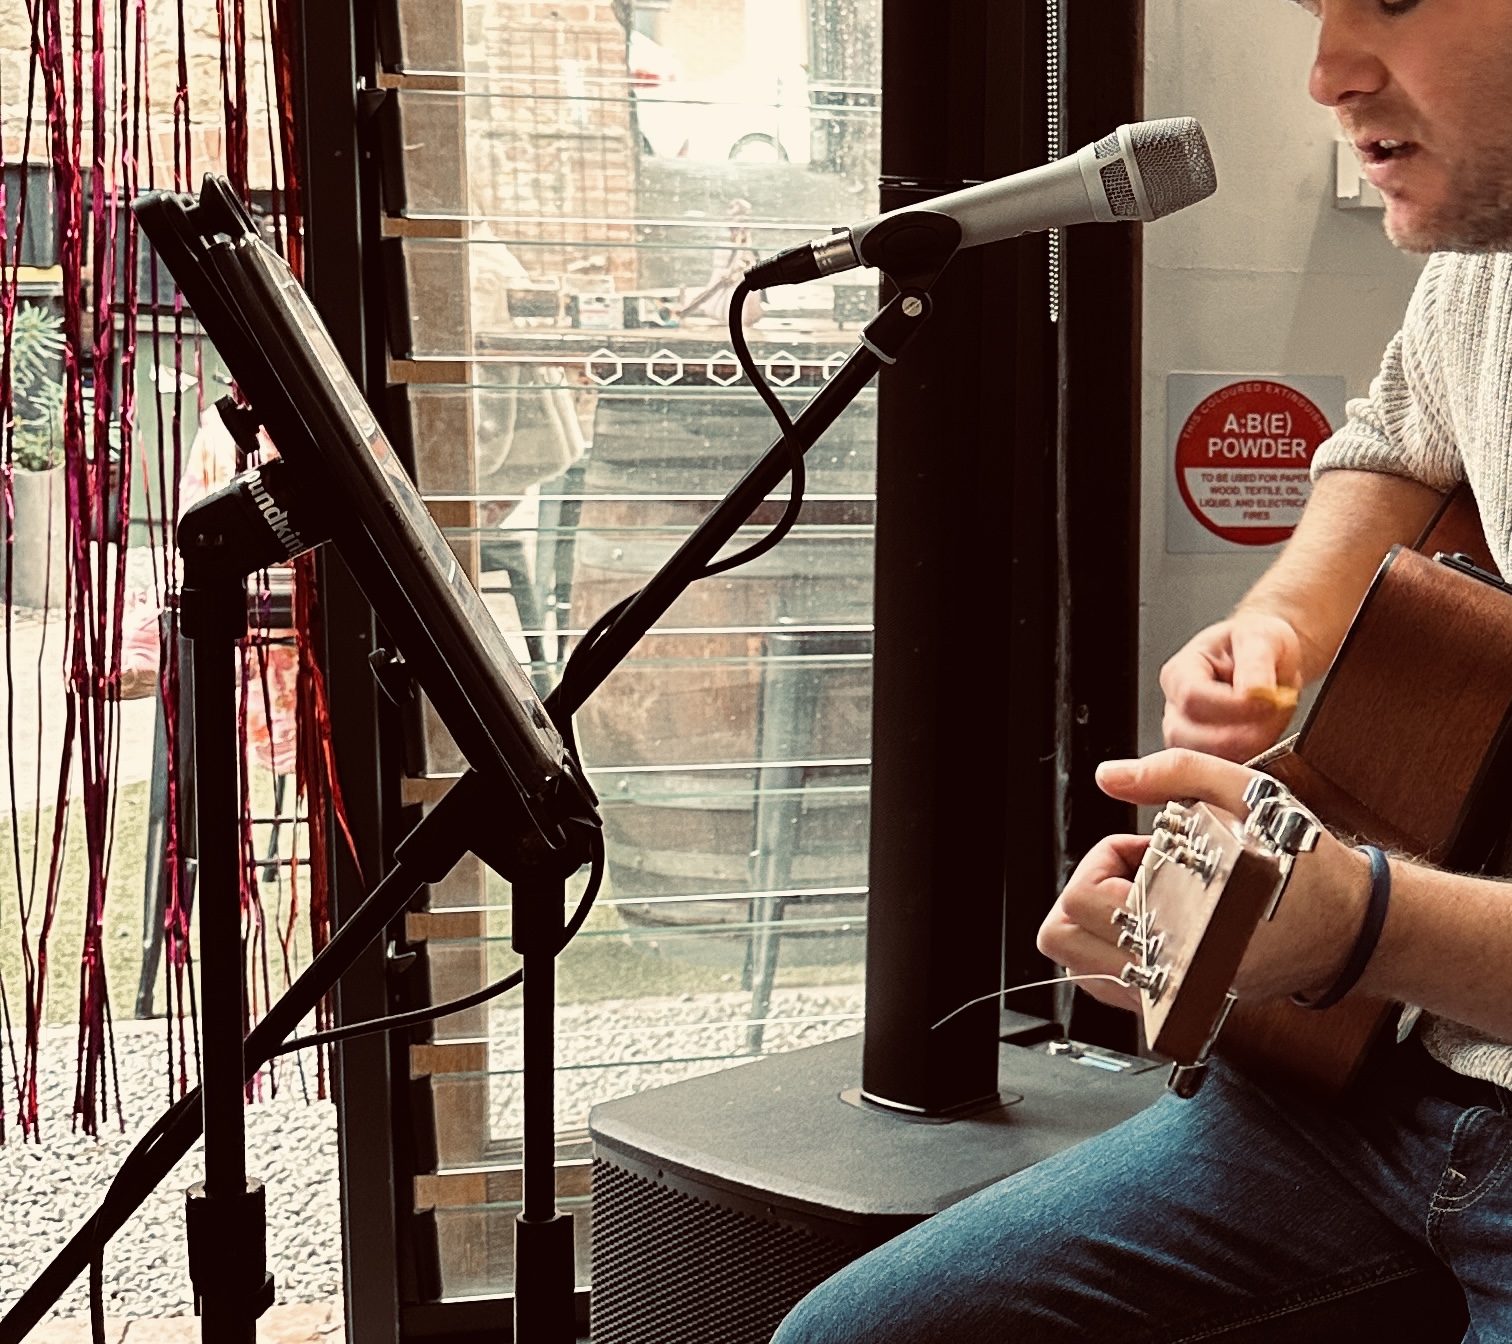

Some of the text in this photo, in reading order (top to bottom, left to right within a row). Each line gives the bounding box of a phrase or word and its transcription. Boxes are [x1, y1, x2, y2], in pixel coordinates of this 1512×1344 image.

[1201, 383, 1262, 414] COLOURED
[1223, 411, 1292, 436] A:B(E)
[1207, 438, 1308, 459] POWDER
[1201, 473, 1215, 483] TO
[1216, 473, 1229, 483] BE
[1231, 473, 1257, 483] USED
[1258, 473, 1278, 483] FOR
[1235, 498, 1255, 508] AND
[1256, 498, 1307, 508] ELECTRICA
[1243, 511, 1271, 521] FIRES
